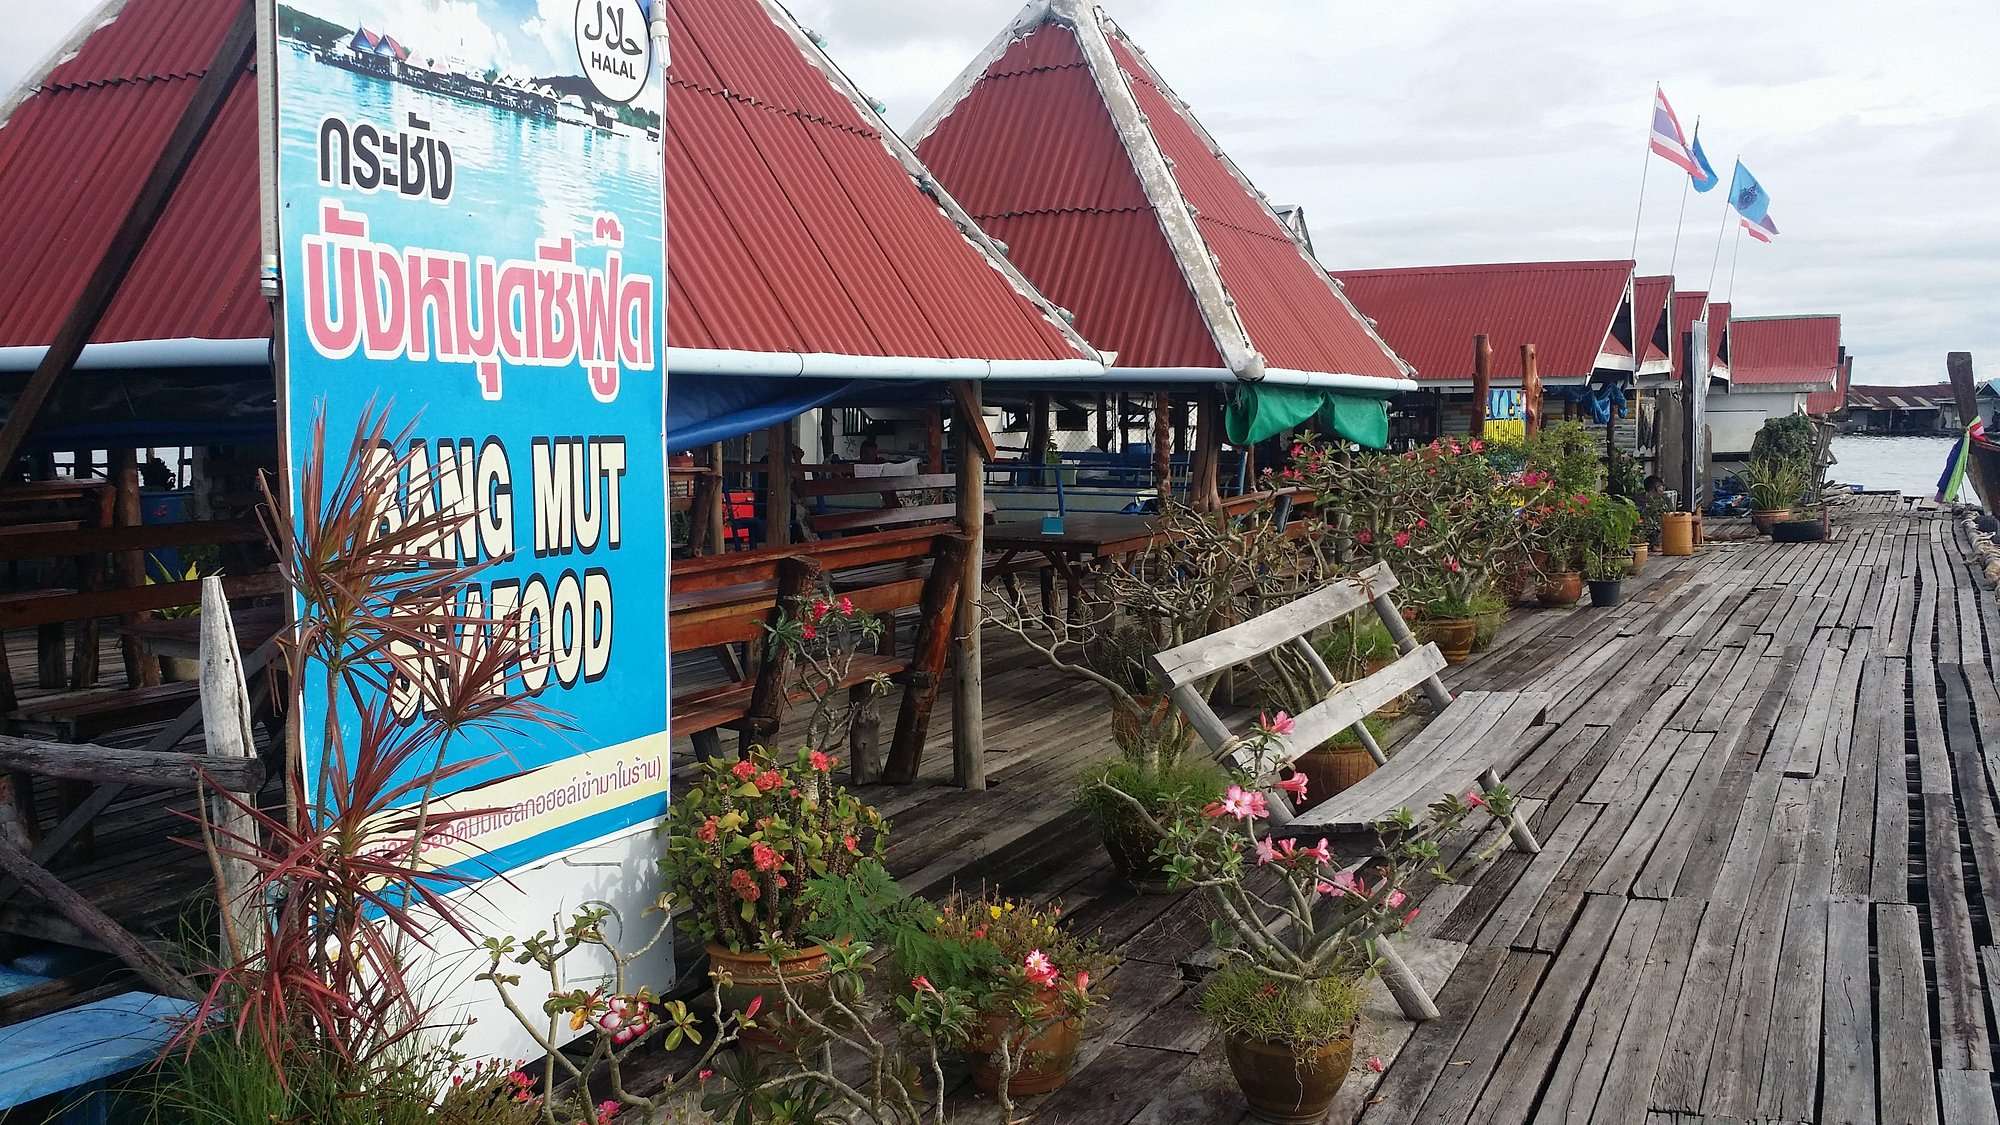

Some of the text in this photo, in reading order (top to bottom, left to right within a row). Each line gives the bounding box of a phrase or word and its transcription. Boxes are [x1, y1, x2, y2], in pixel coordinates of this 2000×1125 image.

[584, 1, 642, 55] حلال
[591, 51, 636, 80] HALAL
[319, 111, 453, 200] กระชัง
[361, 435, 627, 572] BANG MUT
